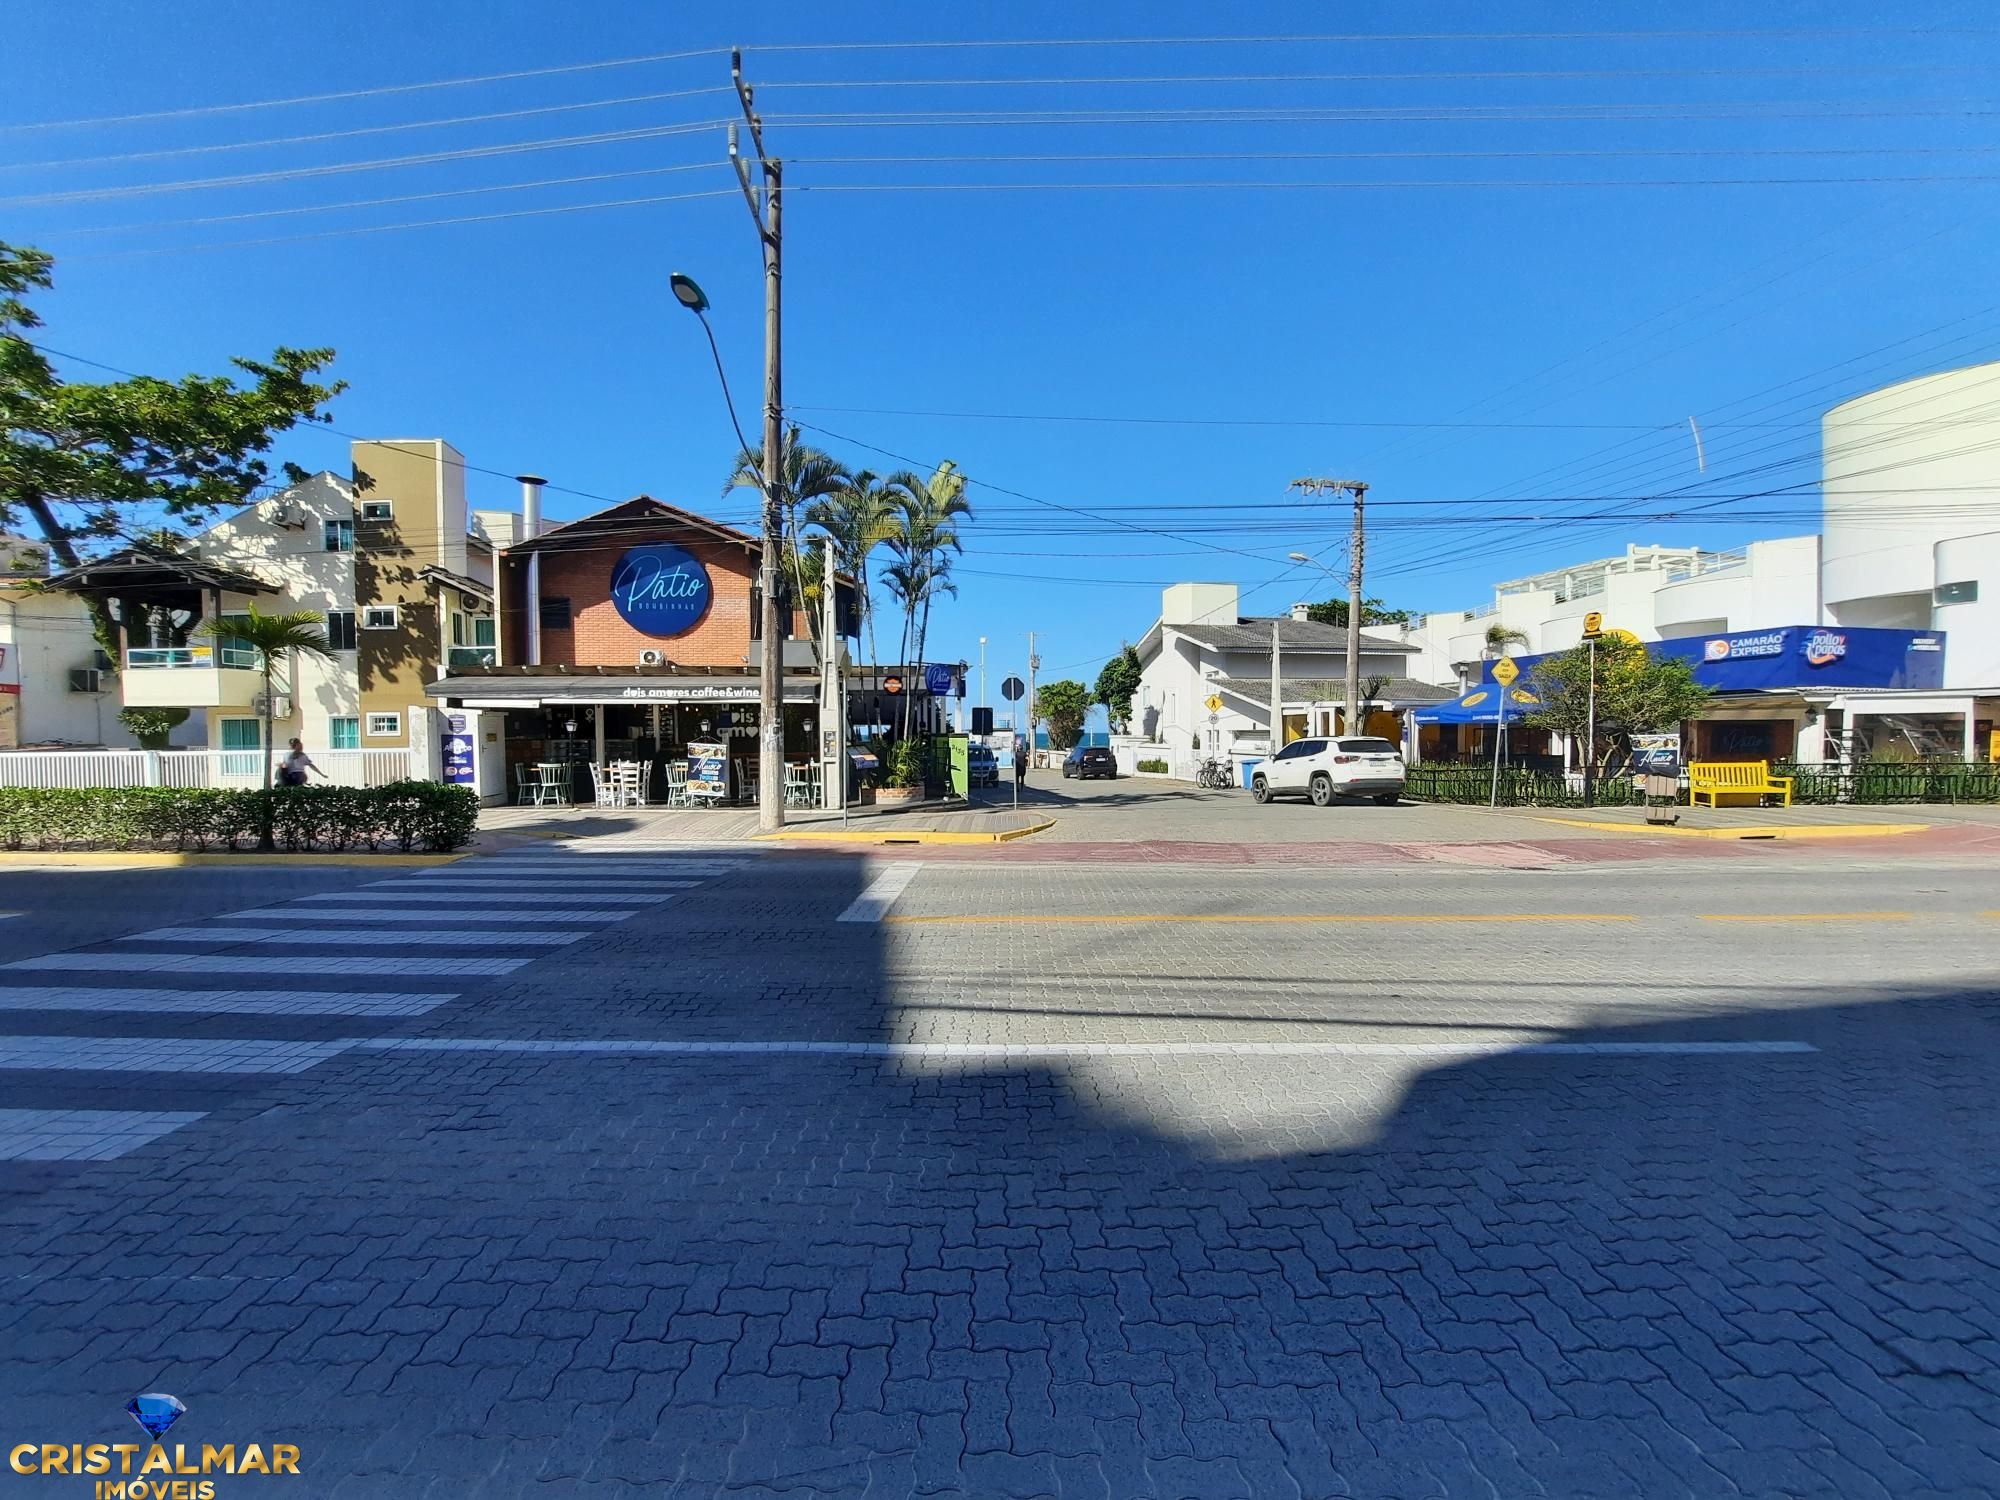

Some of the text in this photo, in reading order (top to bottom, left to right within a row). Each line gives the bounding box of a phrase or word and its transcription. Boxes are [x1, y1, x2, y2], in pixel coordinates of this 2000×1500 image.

[1730, 634, 1782, 647] CAMARÃO
[1812, 633, 1839, 646] pollo
[1731, 644, 1782, 657] EXPRESS
[1815, 644, 1846, 657] papas
[648, 688, 690, 698] amores
